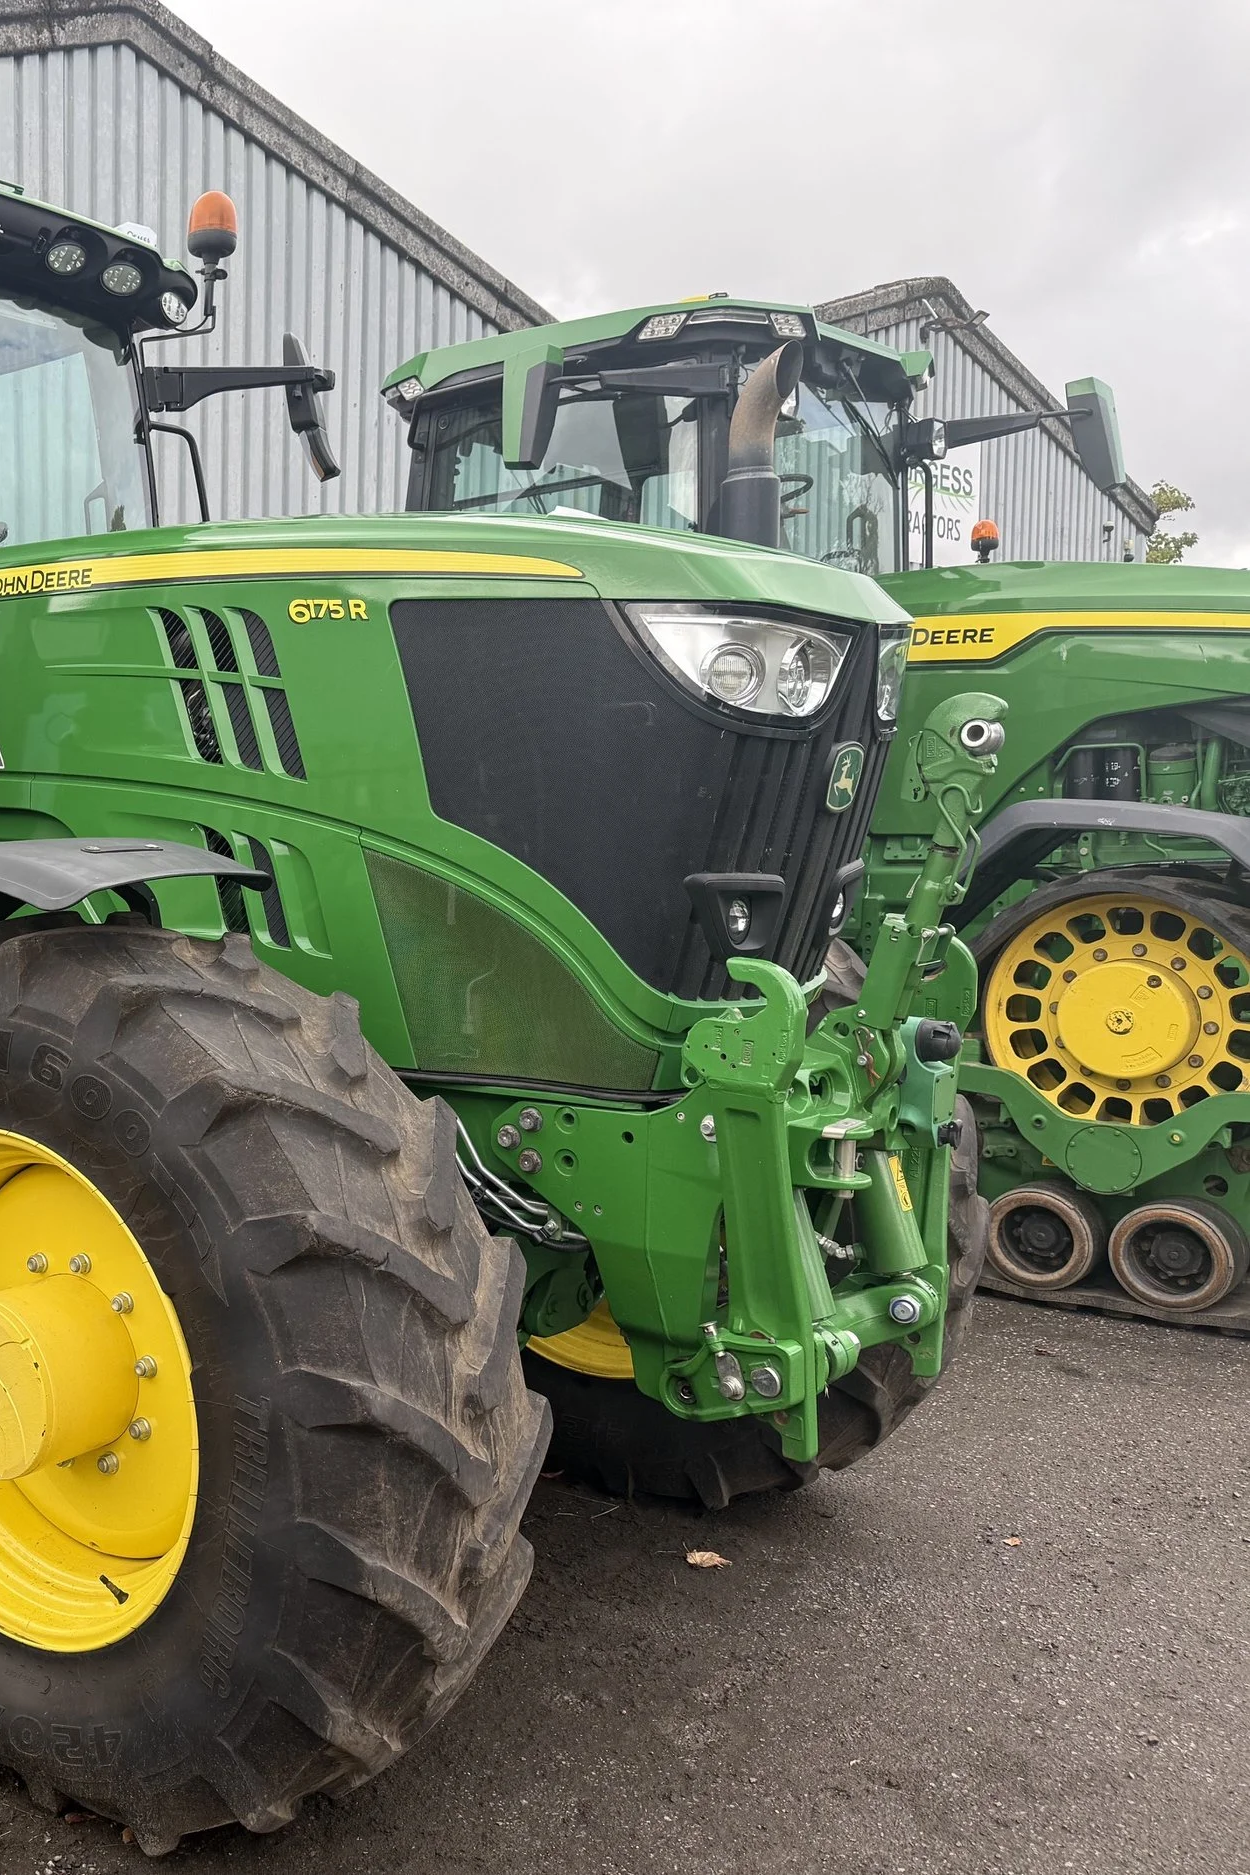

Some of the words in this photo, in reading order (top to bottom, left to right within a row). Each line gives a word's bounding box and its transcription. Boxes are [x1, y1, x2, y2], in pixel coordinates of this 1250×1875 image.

[30, 567, 93, 591] DEERE
[287, 598, 345, 624] 6175
[347, 599, 369, 621] R
[911, 627, 995, 647] DEERE
[198, 1392, 272, 1699] TRELLEBORG
